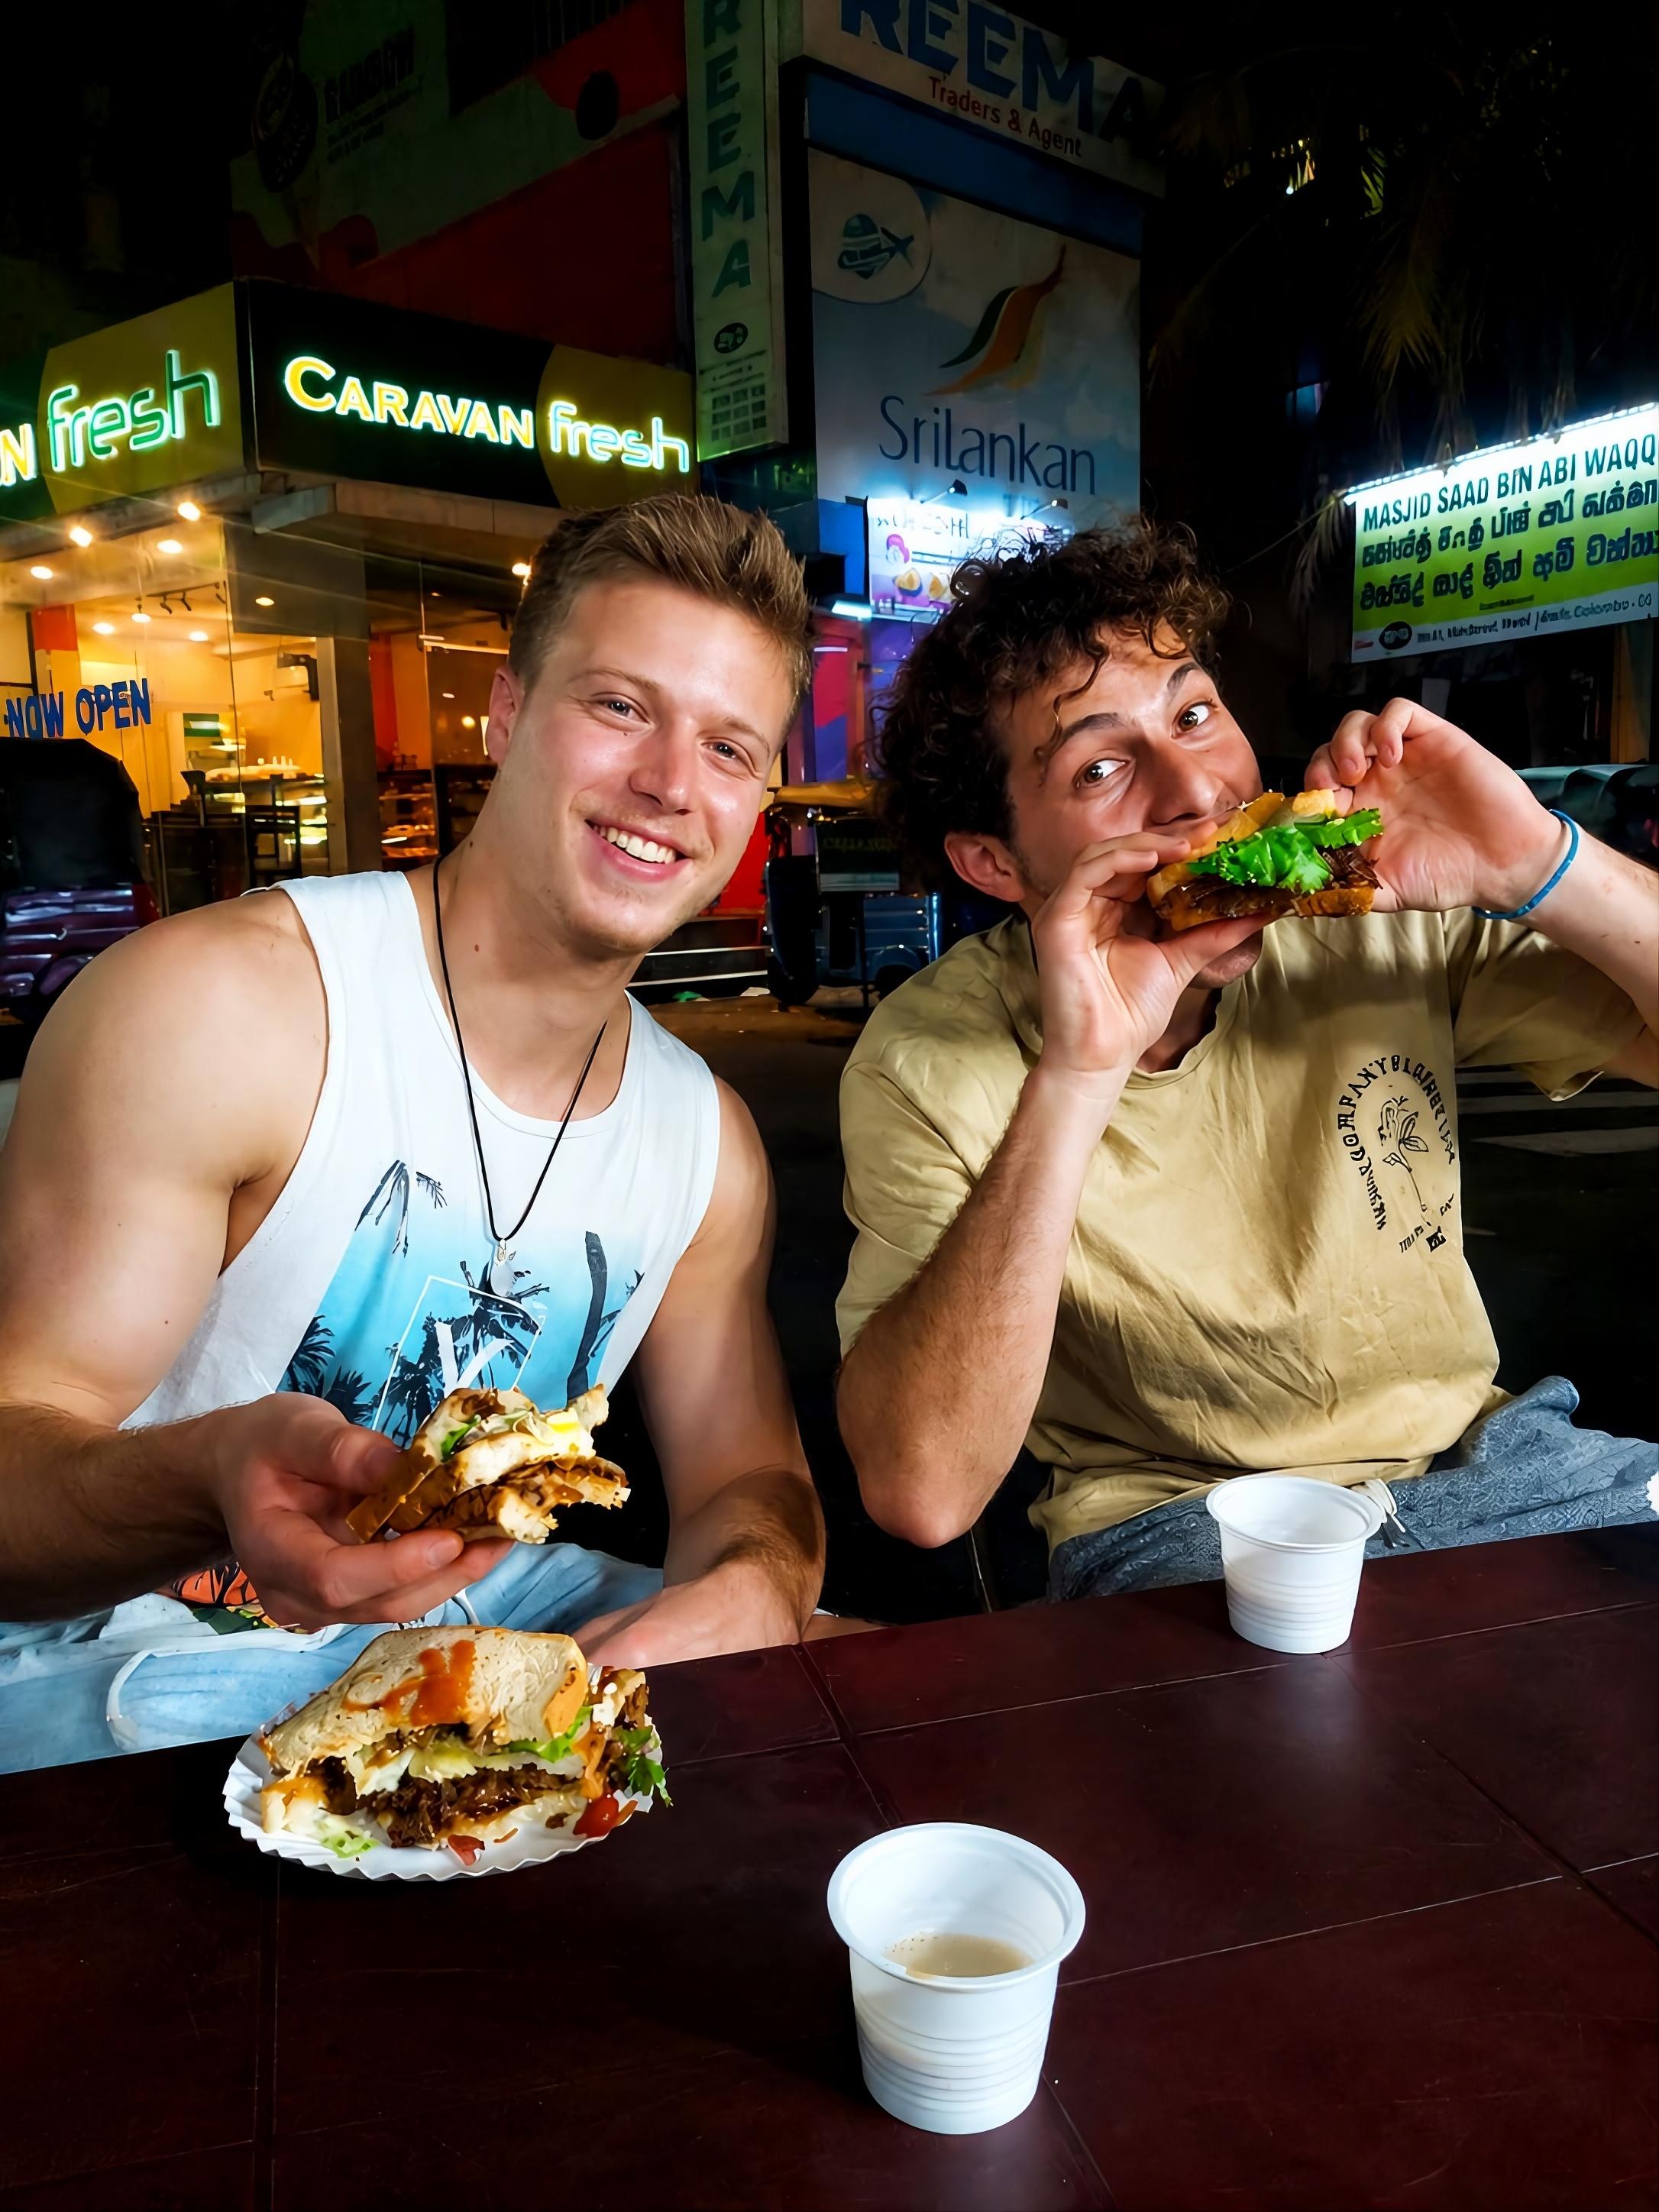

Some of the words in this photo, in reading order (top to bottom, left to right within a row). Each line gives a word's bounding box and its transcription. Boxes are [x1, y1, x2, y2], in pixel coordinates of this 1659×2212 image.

[702, 0, 755, 299] REEMA
[928, 76, 1001, 125] Traders
[1007, 108, 1022, 134] &
[47, 349, 221, 472] fresh
[283, 355, 535, 449] CARAVAN
[548, 399, 690, 473] fresh
[1363, 492, 1431, 532] MASJID
[1437, 477, 1489, 514] SAAD
[1497, 465, 1532, 500] BIN
[1538, 453, 1577, 490] ABI
[6, 690, 64, 740] NOW
[76, 678, 151, 736] OPEN
